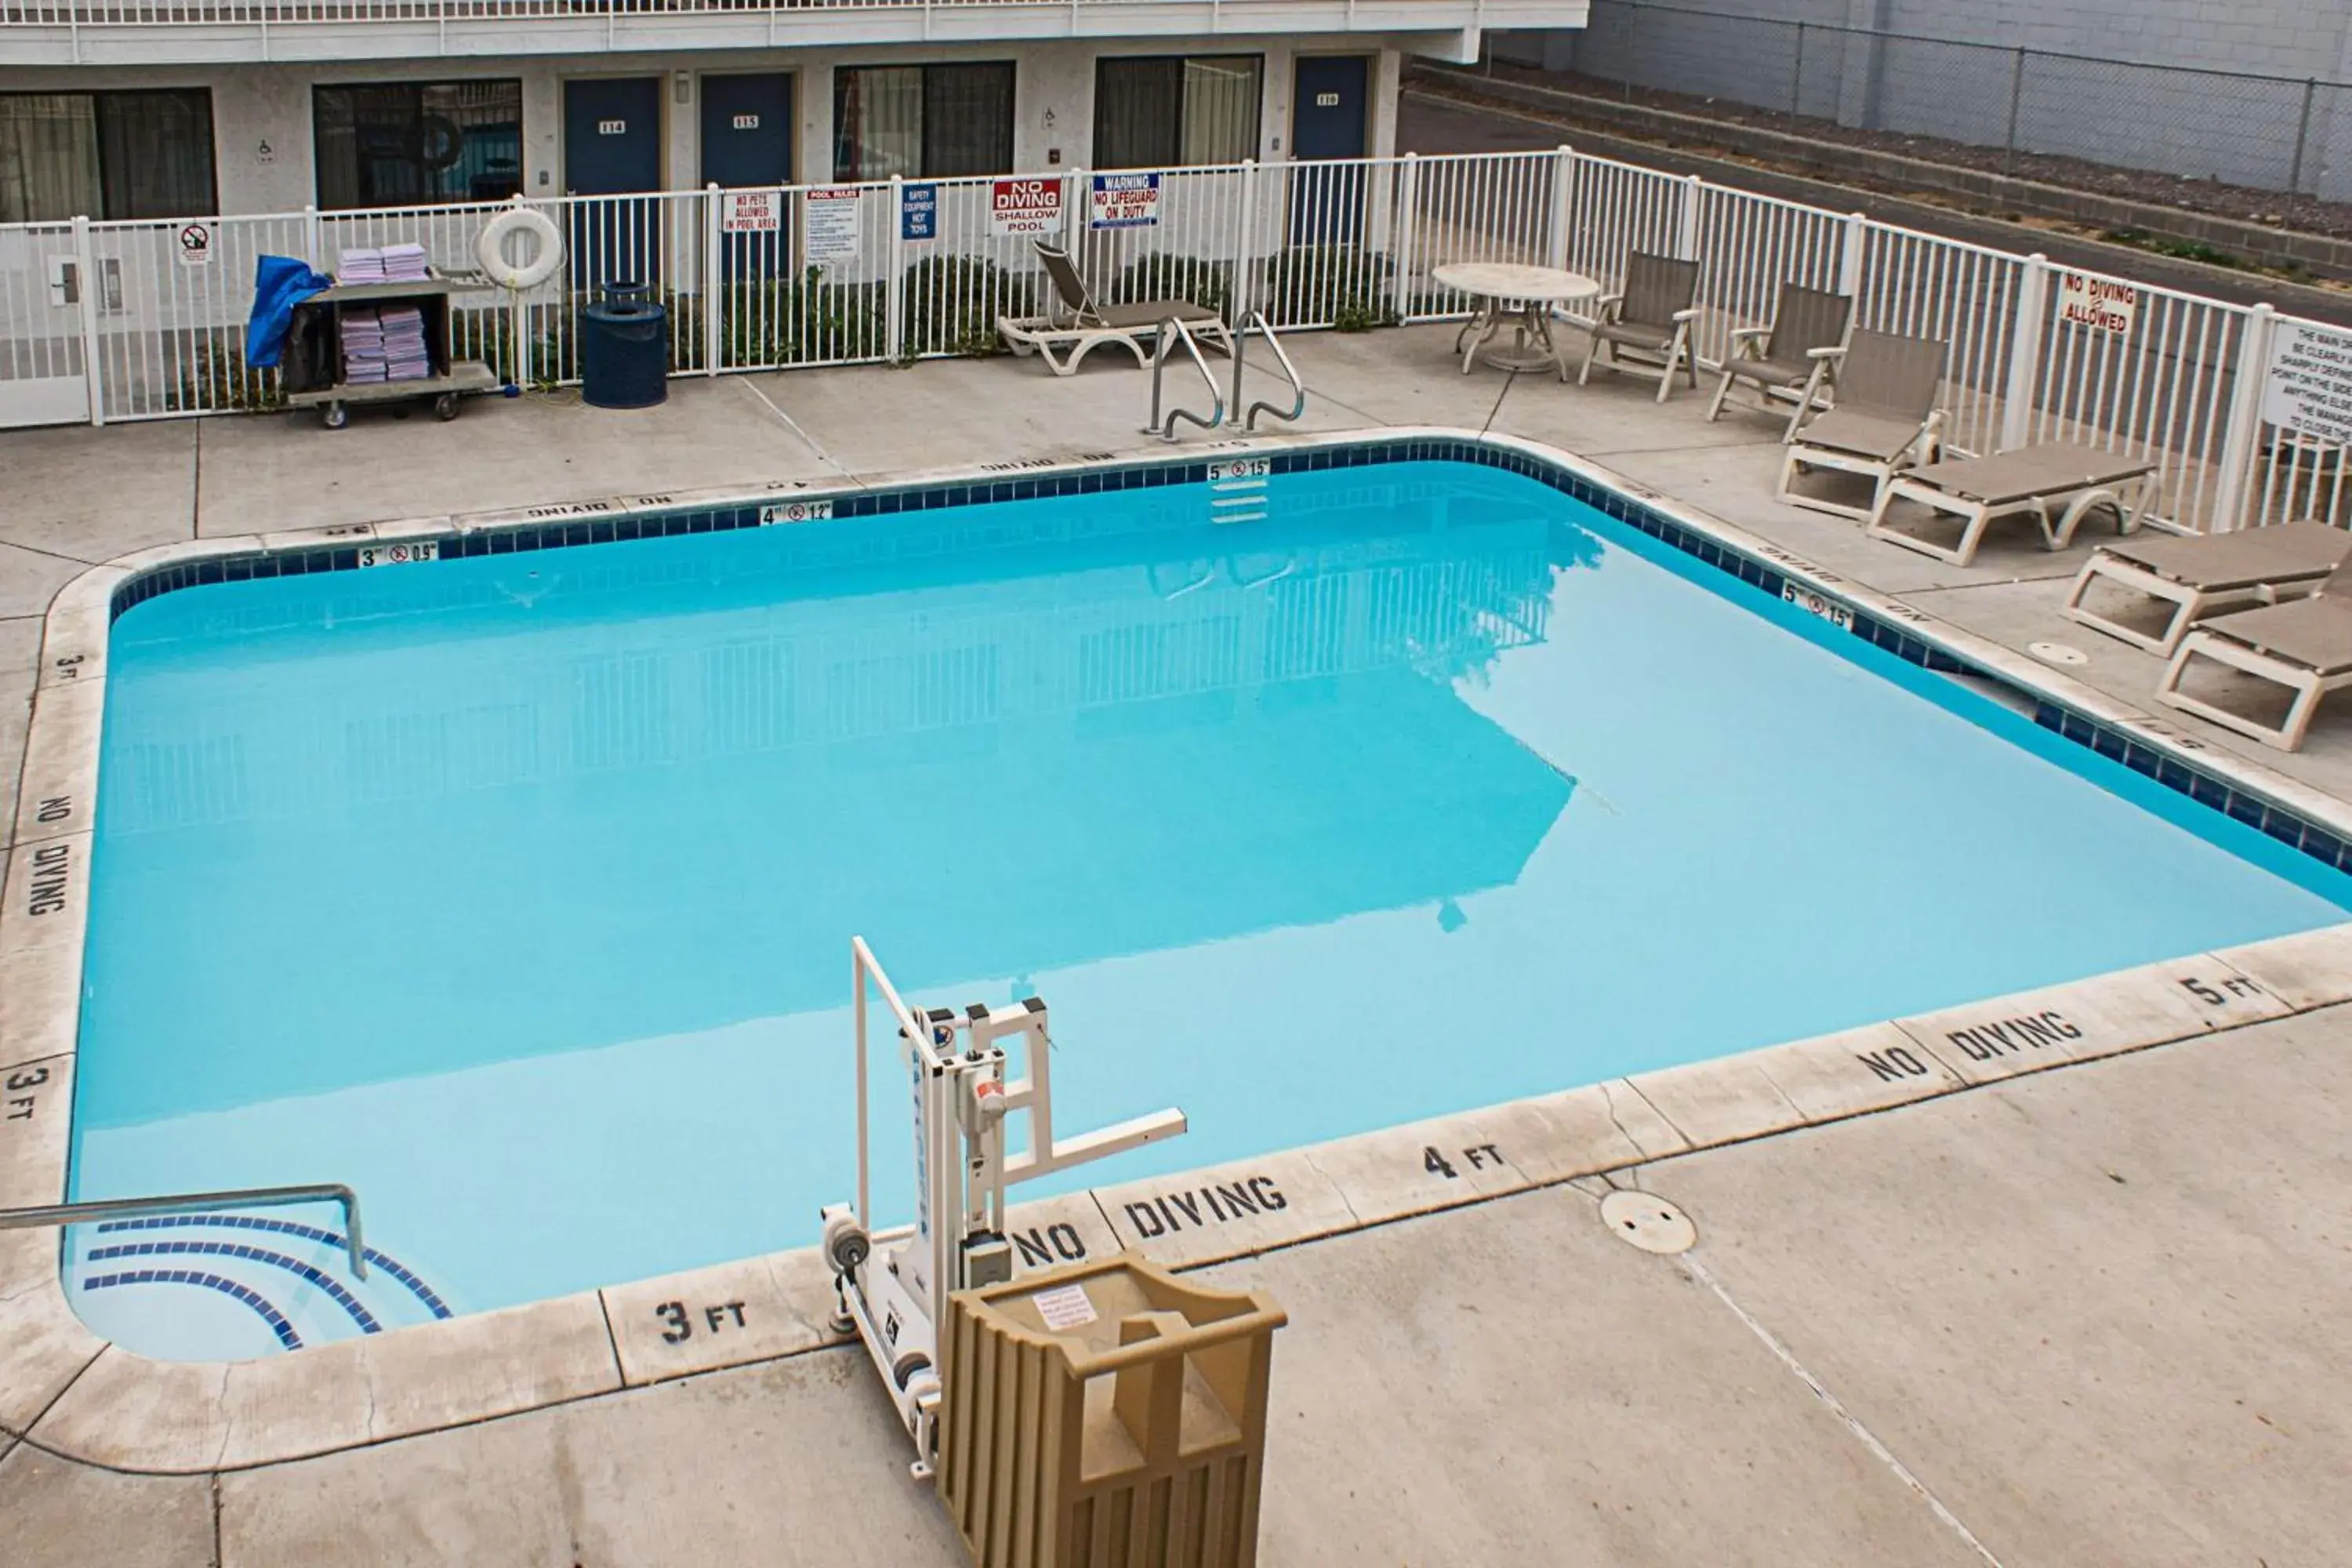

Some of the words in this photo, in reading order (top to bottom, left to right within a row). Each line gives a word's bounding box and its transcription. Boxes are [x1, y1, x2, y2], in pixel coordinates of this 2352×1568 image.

[601, 122, 623, 133] 114
[735, 117, 757, 128] 115
[1011, 181, 1043, 194] NO
[1104, 175, 1149, 190] WARNING
[736, 195, 746, 205] NO
[750, 194, 767, 205] PETS
[833, 190, 857, 198] RULES
[996, 192, 1057, 209] DIVING
[1094, 192, 1108, 205] NO
[1111, 190, 1156, 204] LIFEGUARD
[735, 206, 769, 217] ALLOWED
[996, 209, 1058, 221] SHALLOW
[1105, 206, 1118, 220] ON
[1123, 205, 1146, 218] DUTY
[726, 220, 734, 229] IN
[736, 220, 754, 229] POOL
[758, 219, 777, 229] AREA
[1008, 222, 1046, 231] POOL
[2066, 274, 2082, 292] NO
[2089, 279, 2133, 304] DIVING
[2066, 302, 2126, 331] ALLOWED
[2298, 328, 2315, 341] THE
[2270, 367, 2296, 380] POINT
[2298, 374, 2313, 385] ON
[2314, 378, 2330, 390] THE
[2298, 402, 2314, 416] THE
[981, 459, 1054, 472] DIVING
[639, 496, 673, 506] NO
[528, 503, 608, 518] DIVING
[1757, 546, 1845, 583] DIVING
[1886, 604, 1933, 623] NO
[56, 655, 85, 667] 3
[60, 668, 78, 679] FT
[37, 796, 71, 822] NO
[29, 844, 71, 916] DIVING
[2176, 977, 2226, 1007] 5
[2220, 976, 2264, 999] FT
[1856, 1047, 1928, 1082] NO
[1944, 1011, 2083, 1062] DIVING
[7, 1068, 49, 1091] 3
[6, 1096, 35, 1120] FT
[1425, 1145, 1458, 1179] 4
[1463, 1143, 1504, 1170] FT
[1010, 1221, 1087, 1269] NO
[1123, 1176, 1288, 1240] DIVING
[655, 1301, 691, 1345] 3
[705, 1301, 746, 1334] FT
